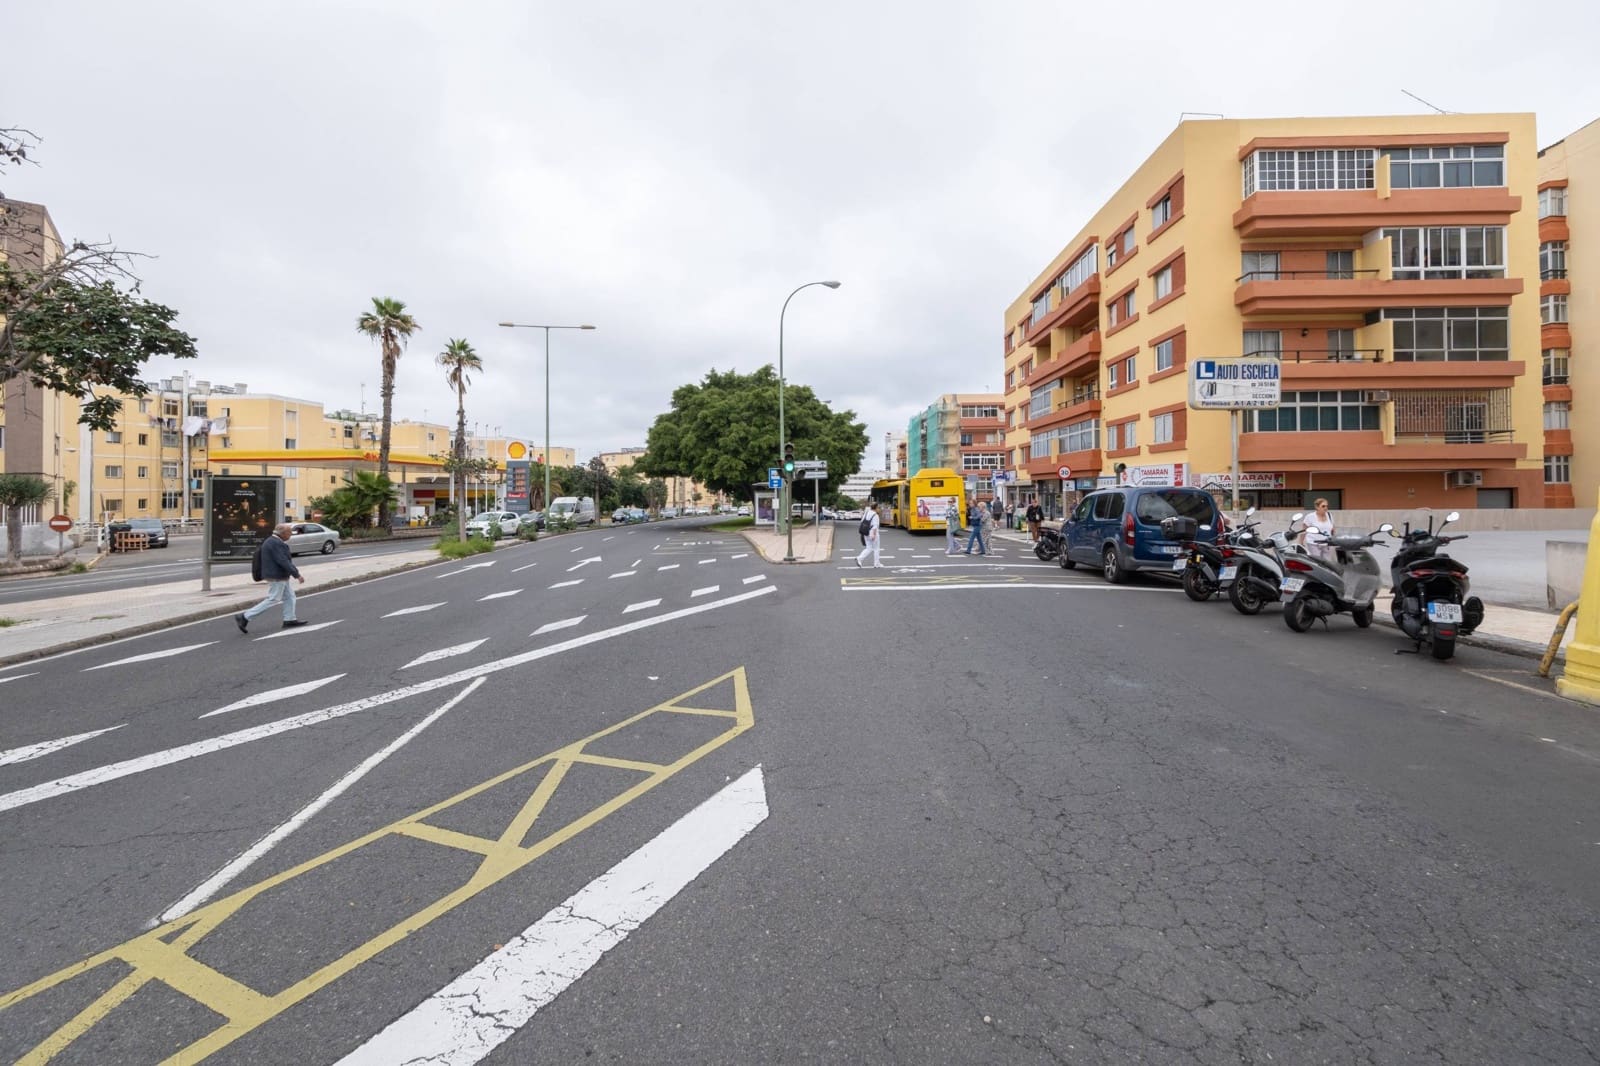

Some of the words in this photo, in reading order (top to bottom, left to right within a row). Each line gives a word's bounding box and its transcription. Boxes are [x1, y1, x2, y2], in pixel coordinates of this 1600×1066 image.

[1217, 364, 1239, 380] AUTO
[1241, 364, 1279, 380] ESCUELA
[1141, 468, 1169, 476] TAMARAN
